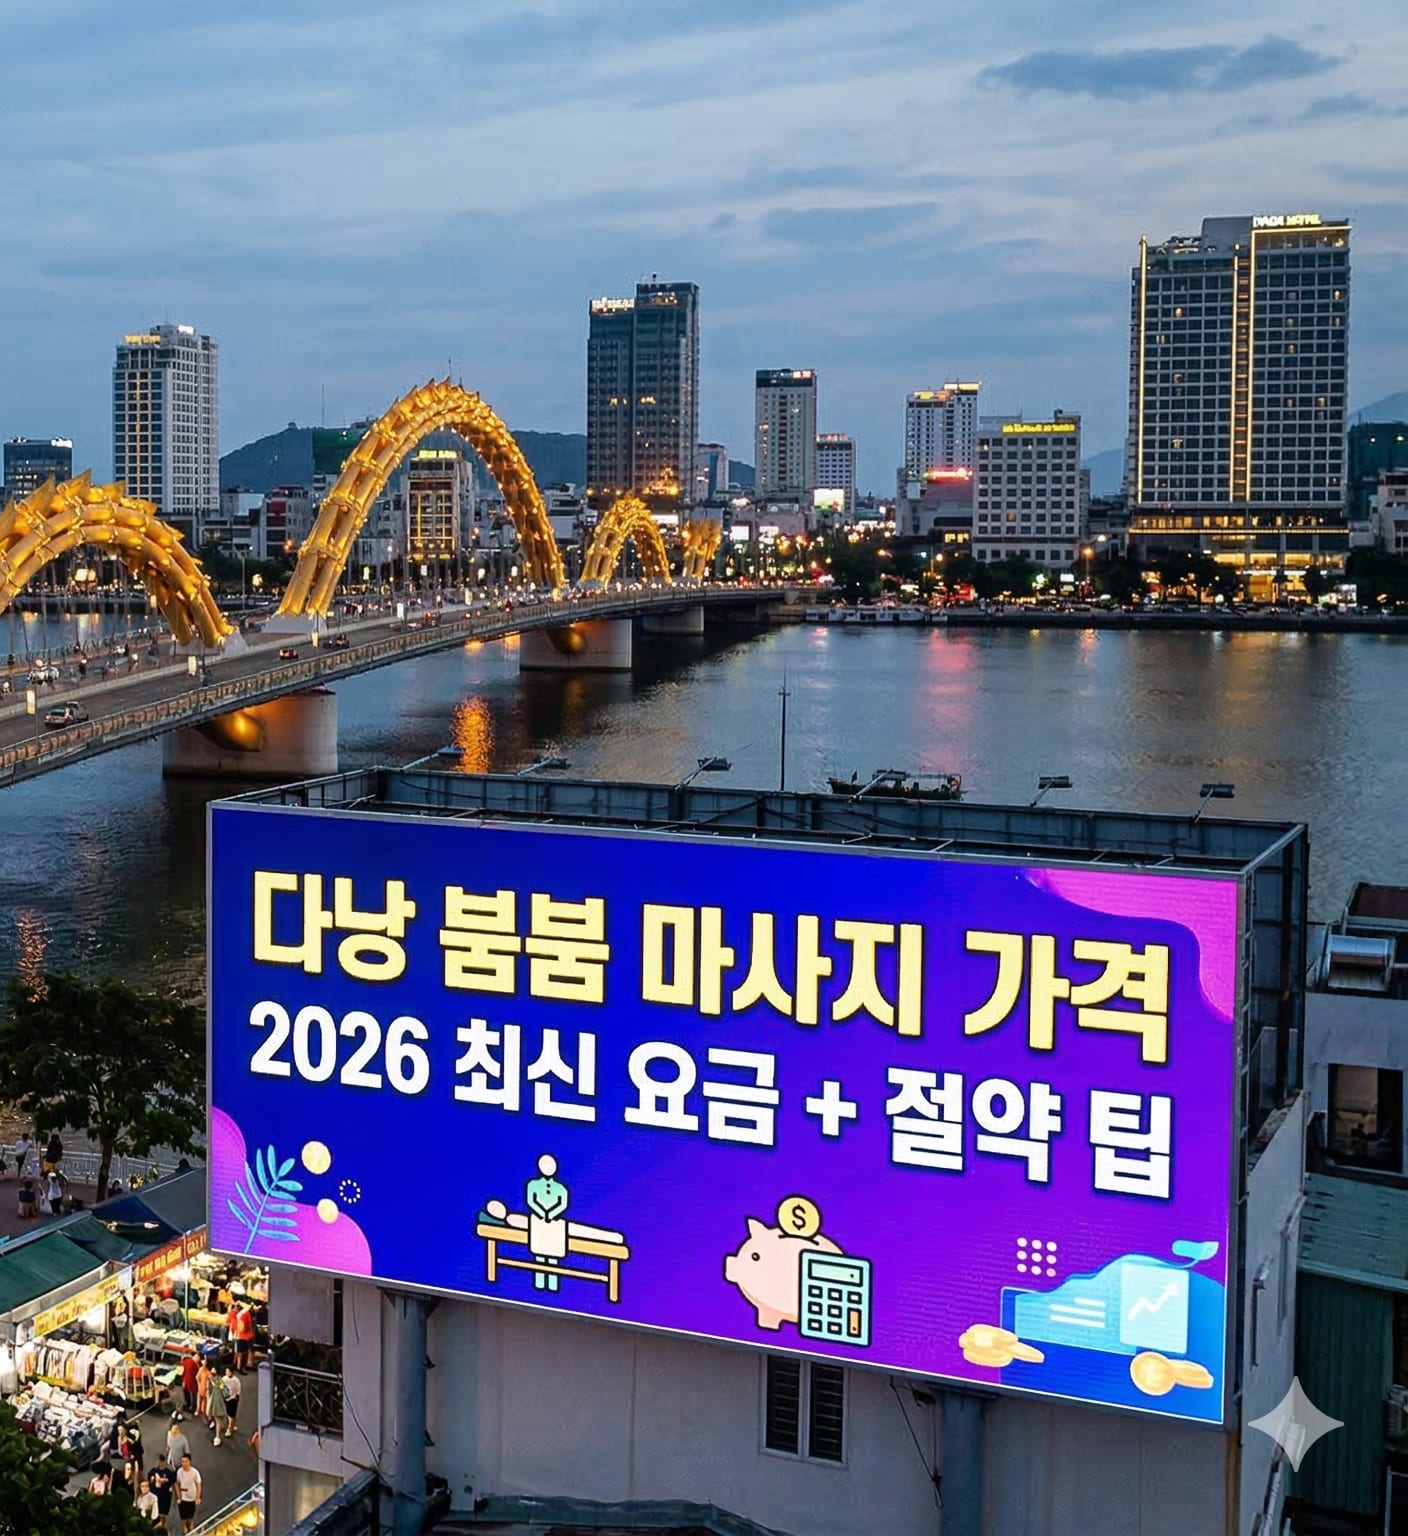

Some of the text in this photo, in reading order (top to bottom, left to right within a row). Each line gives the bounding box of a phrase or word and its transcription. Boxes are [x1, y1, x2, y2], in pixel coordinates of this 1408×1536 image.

[253, 870, 1170, 1064] 다낭 붐붐 마사지 가격
[249, 1000, 1172, 1200] 2026 최신 요금 + 절약 팁
